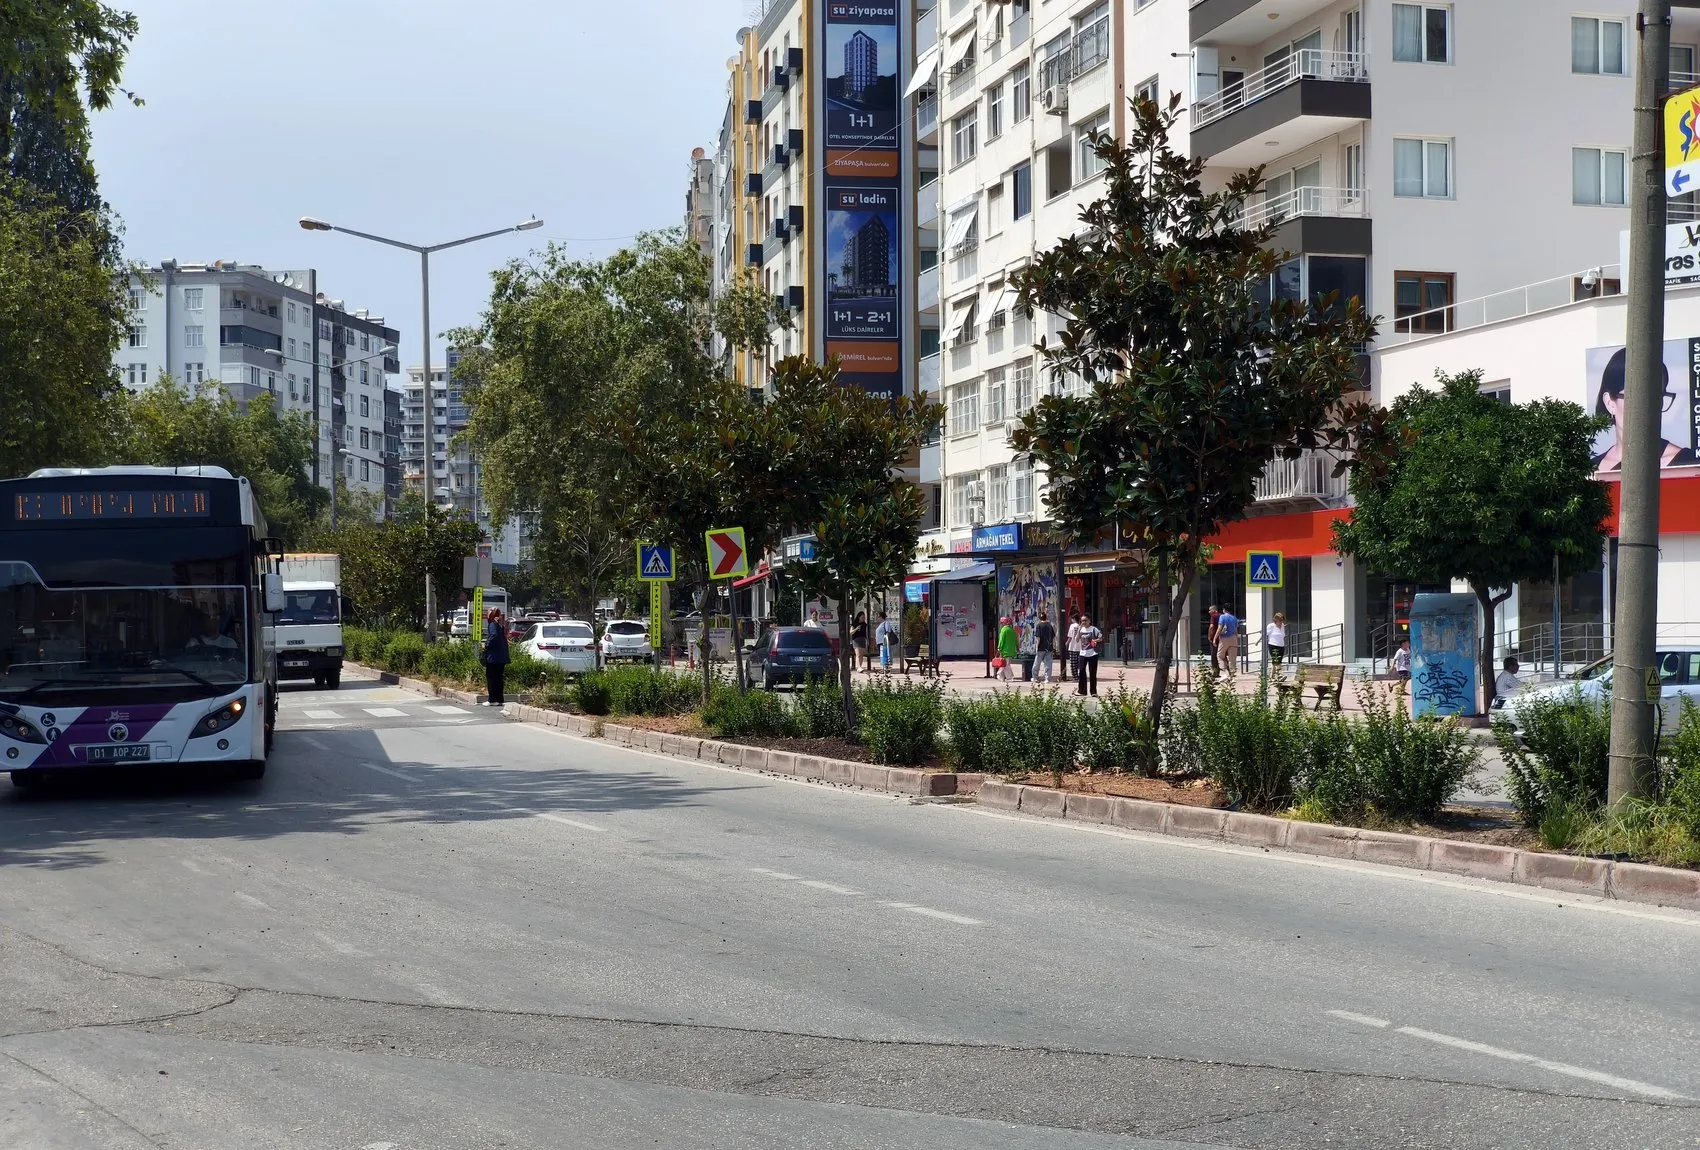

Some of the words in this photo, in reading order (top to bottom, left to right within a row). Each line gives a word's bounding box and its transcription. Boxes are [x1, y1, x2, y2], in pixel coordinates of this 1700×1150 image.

[833, 6, 846, 15] su
[849, 113, 873, 127] 1+1
[842, 194, 855, 204] su
[859, 193, 887, 204] ladin
[834, 311, 851, 322] 1+1
[867, 311, 891, 323] 2+1
[976, 534, 999, 549] ARMAĞAN
[999, 533, 1015, 546] TEKEL
[94, 749, 105, 758] 01
[131, 746, 148, 756] 227
